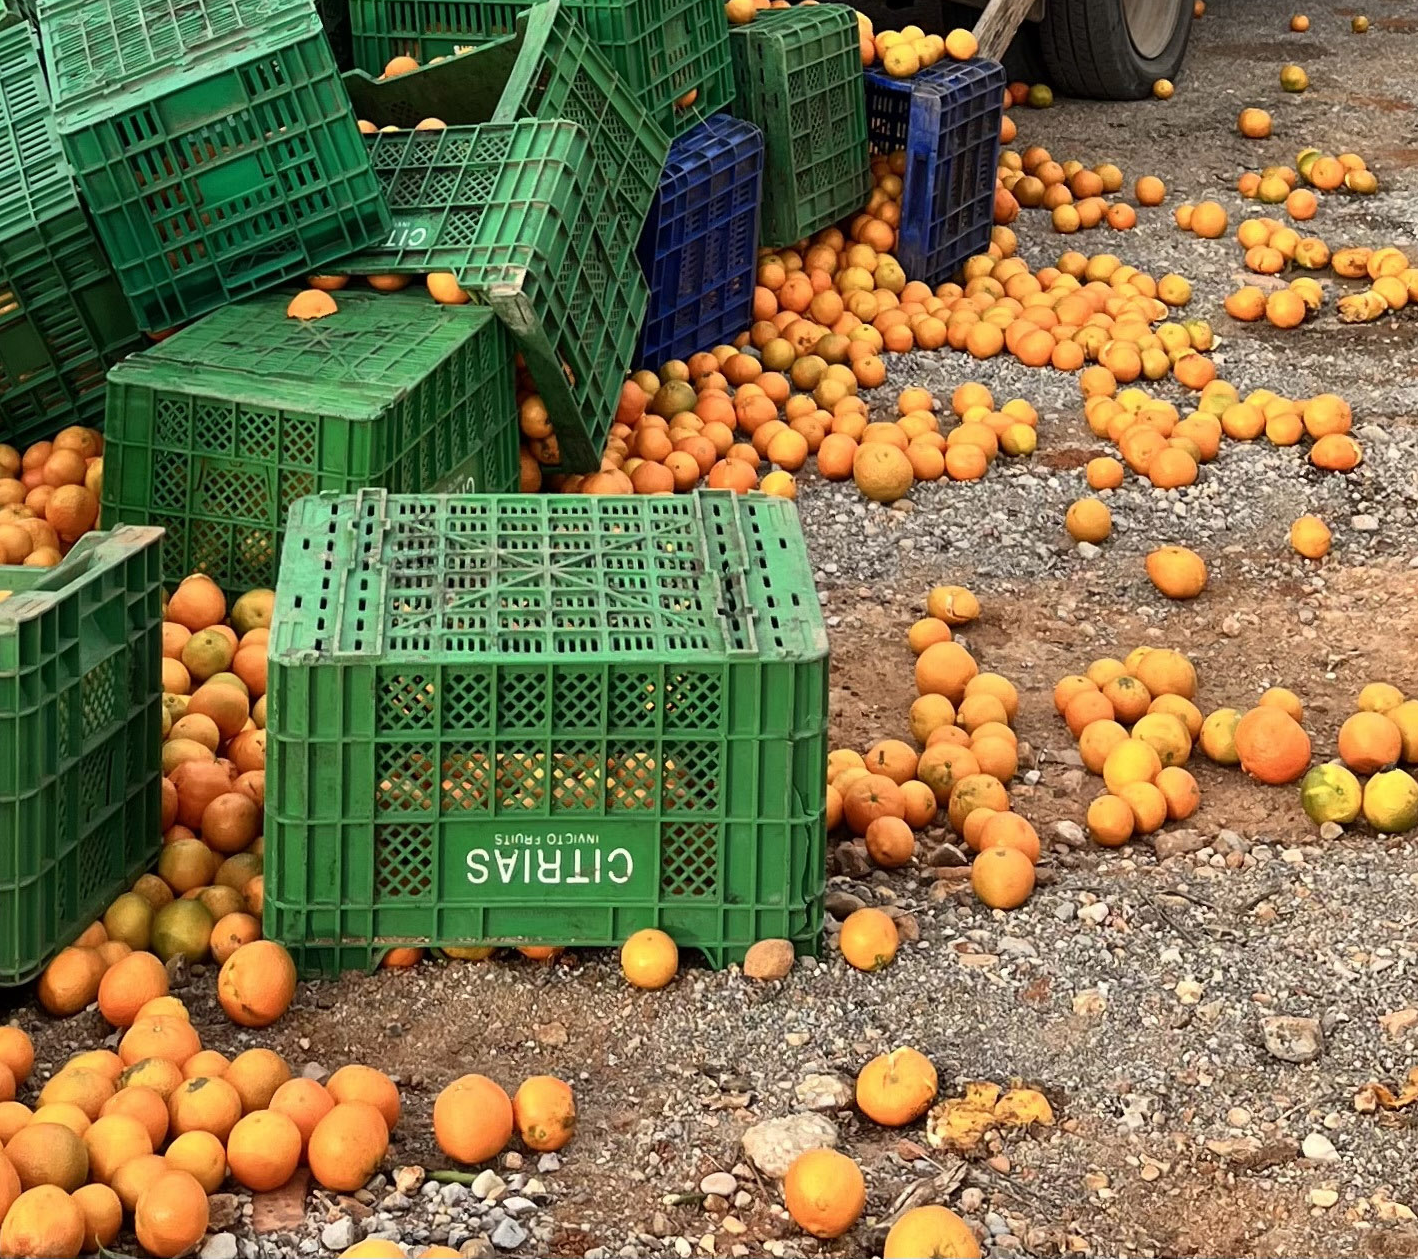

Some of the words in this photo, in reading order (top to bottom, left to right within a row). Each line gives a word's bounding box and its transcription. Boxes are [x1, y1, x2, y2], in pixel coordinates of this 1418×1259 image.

[494, 833, 540, 846] FRUITS
[546, 832, 599, 845] INVICTO
[466, 848, 634, 884] CITRIAS
